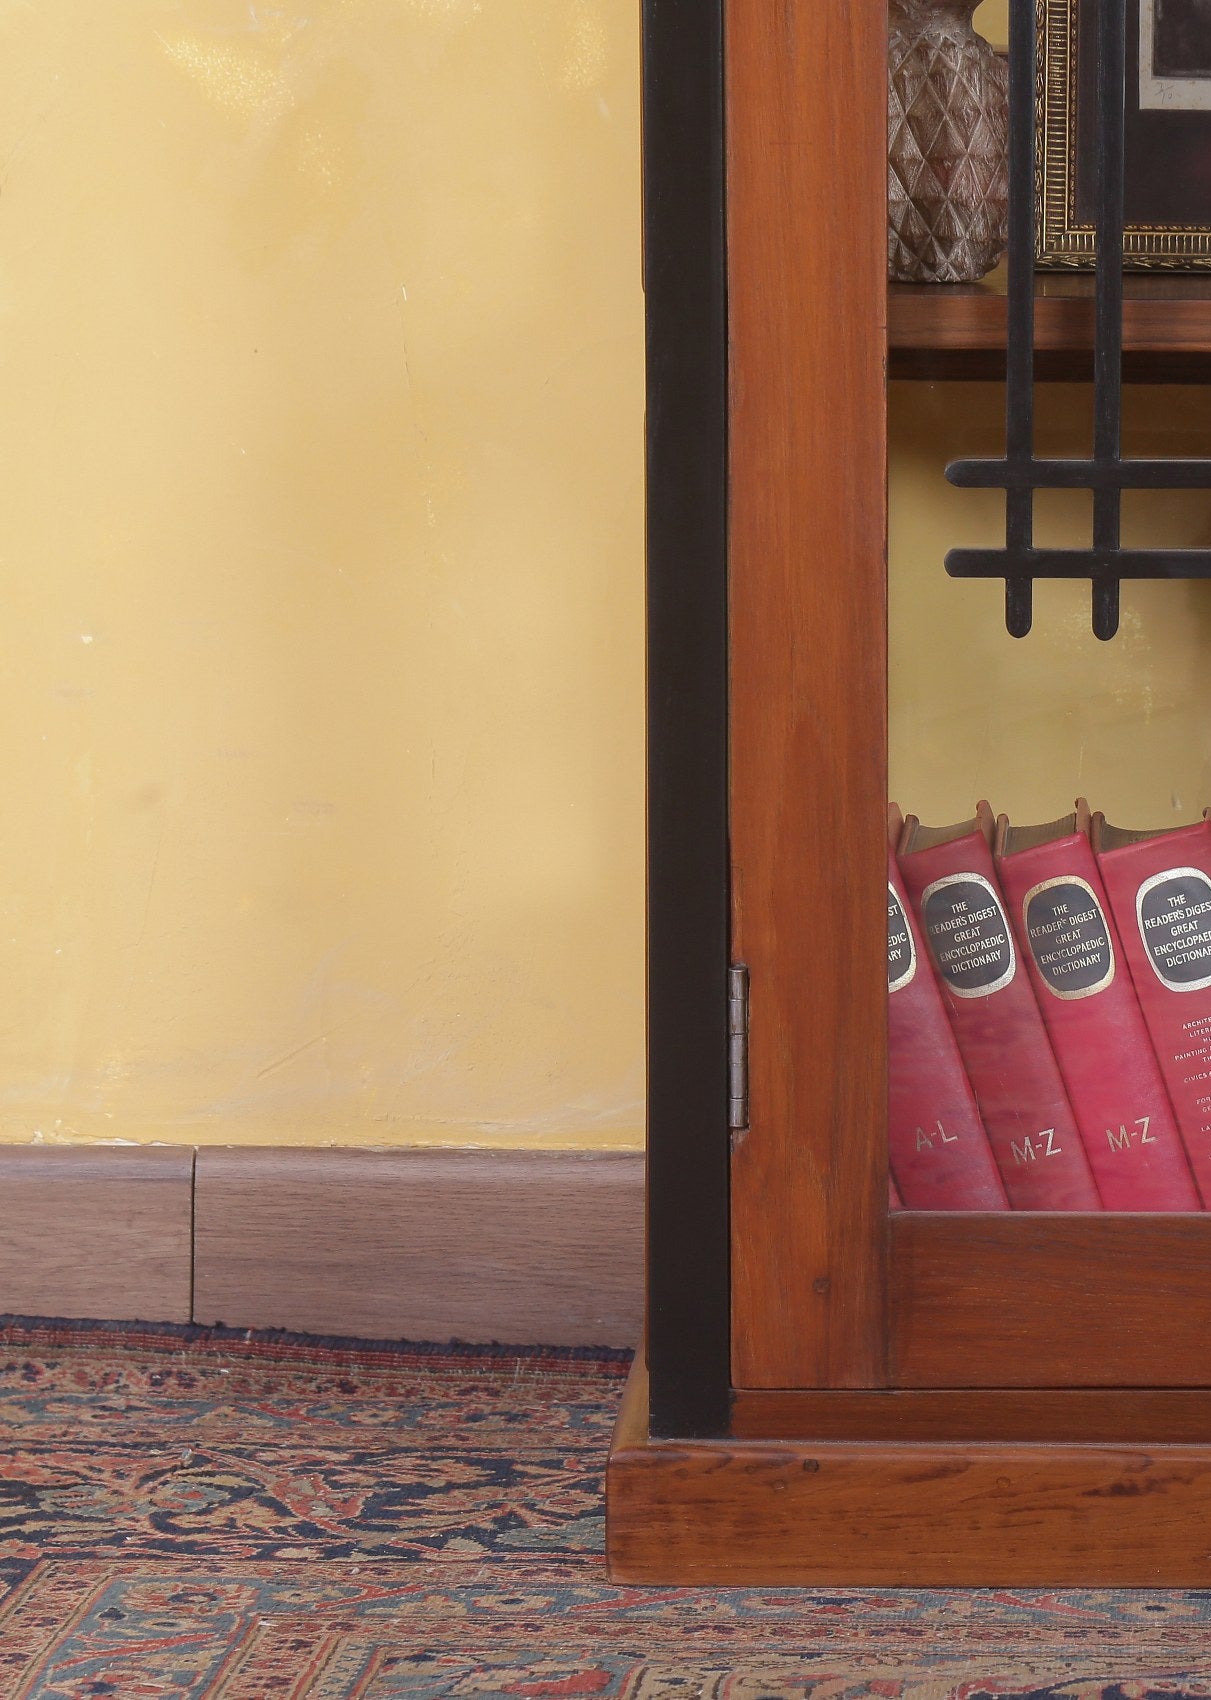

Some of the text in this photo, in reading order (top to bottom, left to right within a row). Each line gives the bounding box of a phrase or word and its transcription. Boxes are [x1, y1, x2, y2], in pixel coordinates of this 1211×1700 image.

[951, 901, 968, 914] THE
[1052, 903, 1069, 916] THE
[1167, 894, 1187, 908] THE
[930, 905, 997, 935] READER'S DIGEST
[1068, 908, 1098, 926] DIGEST
[1144, 909, 1185, 930] READER'S
[954, 926, 981, 943] GREAT
[1055, 928, 1081, 944] GREAT
[1170, 920, 1199, 936] GREAT
[941, 934, 1005, 962] ENCYCLOPAEDIC
[1040, 936, 1105, 964] ENCYCLOPAEDIC
[951, 949, 1002, 973] DICTIONARY
[1052, 952, 1101, 976] DICTIONARY
[1174, 1048, 1208, 1061] PAINTING
[1184, 1072, 1208, 1083] CIVICS
[915, 1120, 958, 1152] A-L
[1106, 1116, 1156, 1152] M-Z
[1010, 1128, 1062, 1165] M-Z
